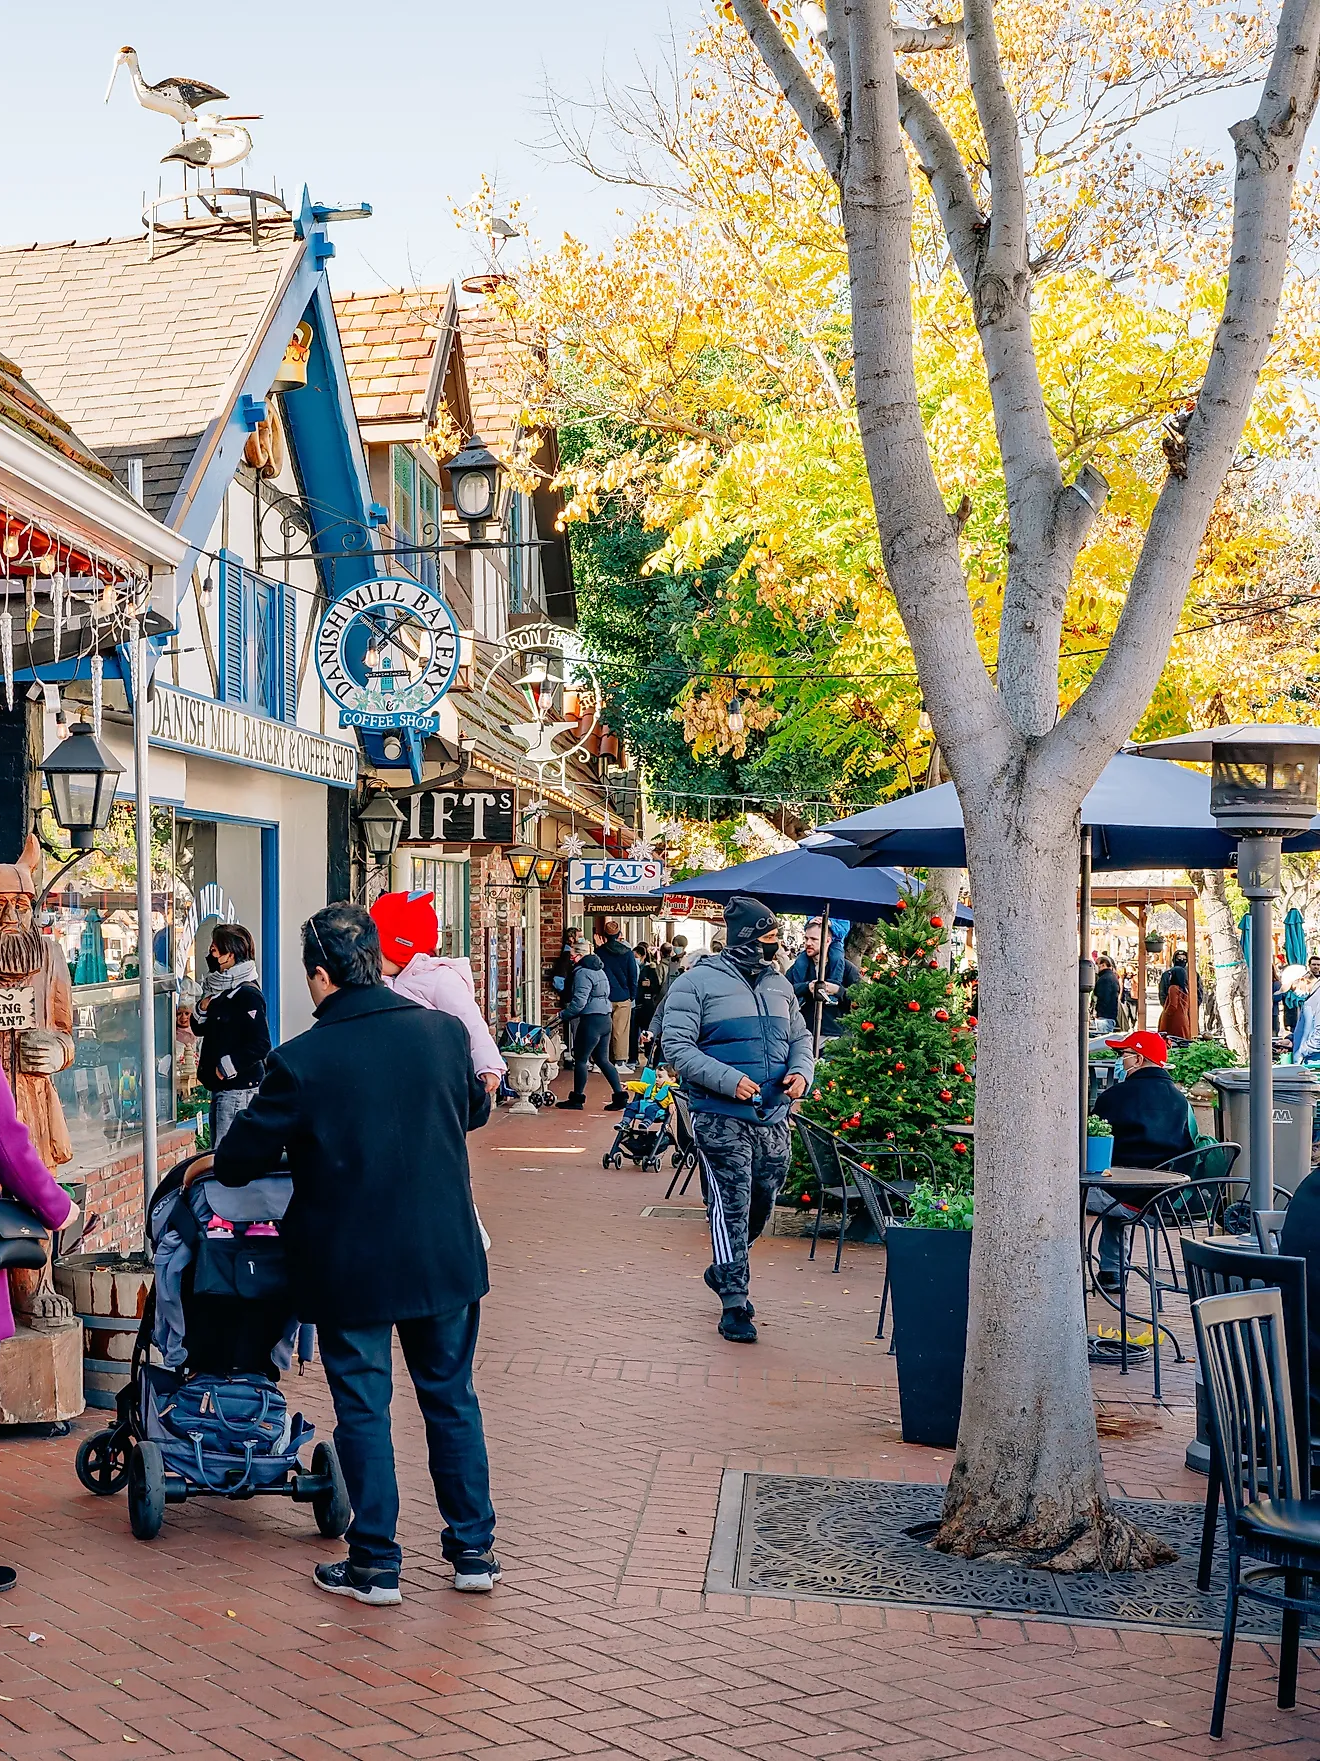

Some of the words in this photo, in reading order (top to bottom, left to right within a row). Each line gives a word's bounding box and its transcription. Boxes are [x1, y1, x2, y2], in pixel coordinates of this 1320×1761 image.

[319, 609, 354, 700] DANISH
[342, 582, 405, 614] MILL
[411, 590, 455, 697] BAKERY
[385, 700, 394, 712] &
[342, 711, 396, 727] COFFEE
[399, 713, 435, 730] SHOP
[151, 687, 206, 747] DANISH
[209, 705, 241, 756] MILL
[243, 715, 288, 767] BAKERY
[289, 731, 296, 769] &
[297, 734, 331, 778] COFFEE
[332, 745, 354, 783] SHOP
[394, 790, 513, 841] IFTS
[575, 863, 656, 891] HATS
[587, 902, 615, 912] Famous
